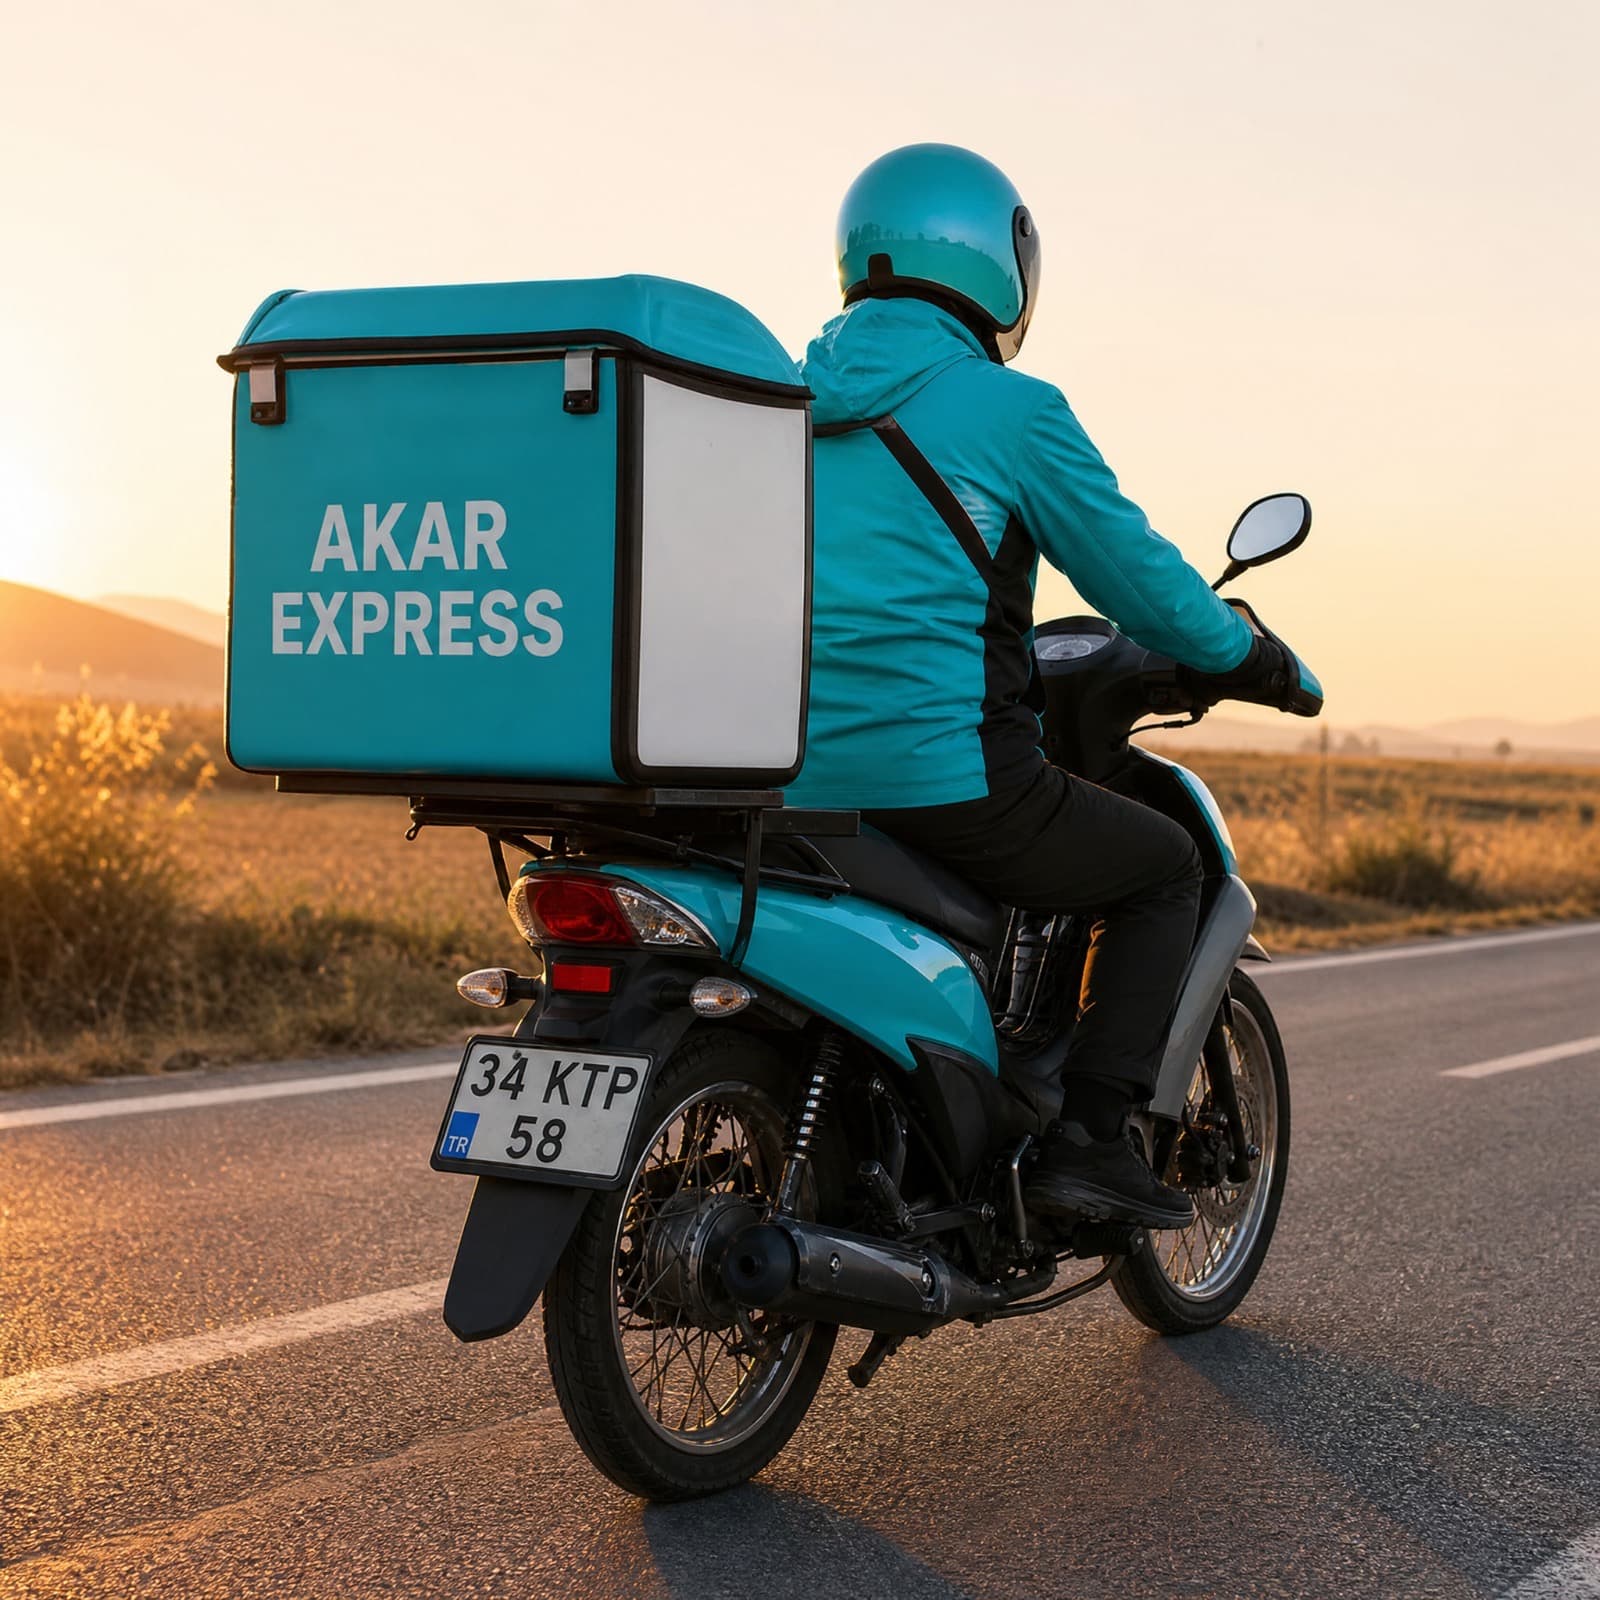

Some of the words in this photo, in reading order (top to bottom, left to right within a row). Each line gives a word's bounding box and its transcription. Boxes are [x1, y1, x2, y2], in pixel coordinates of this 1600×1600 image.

[310, 500, 508, 572] AKAR
[272, 589, 564, 657] EXPRESS
[470, 1053, 528, 1100] 34
[542, 1060, 638, 1110] KTP
[449, 1136, 469, 1154] TR
[505, 1115, 566, 1163] 58
